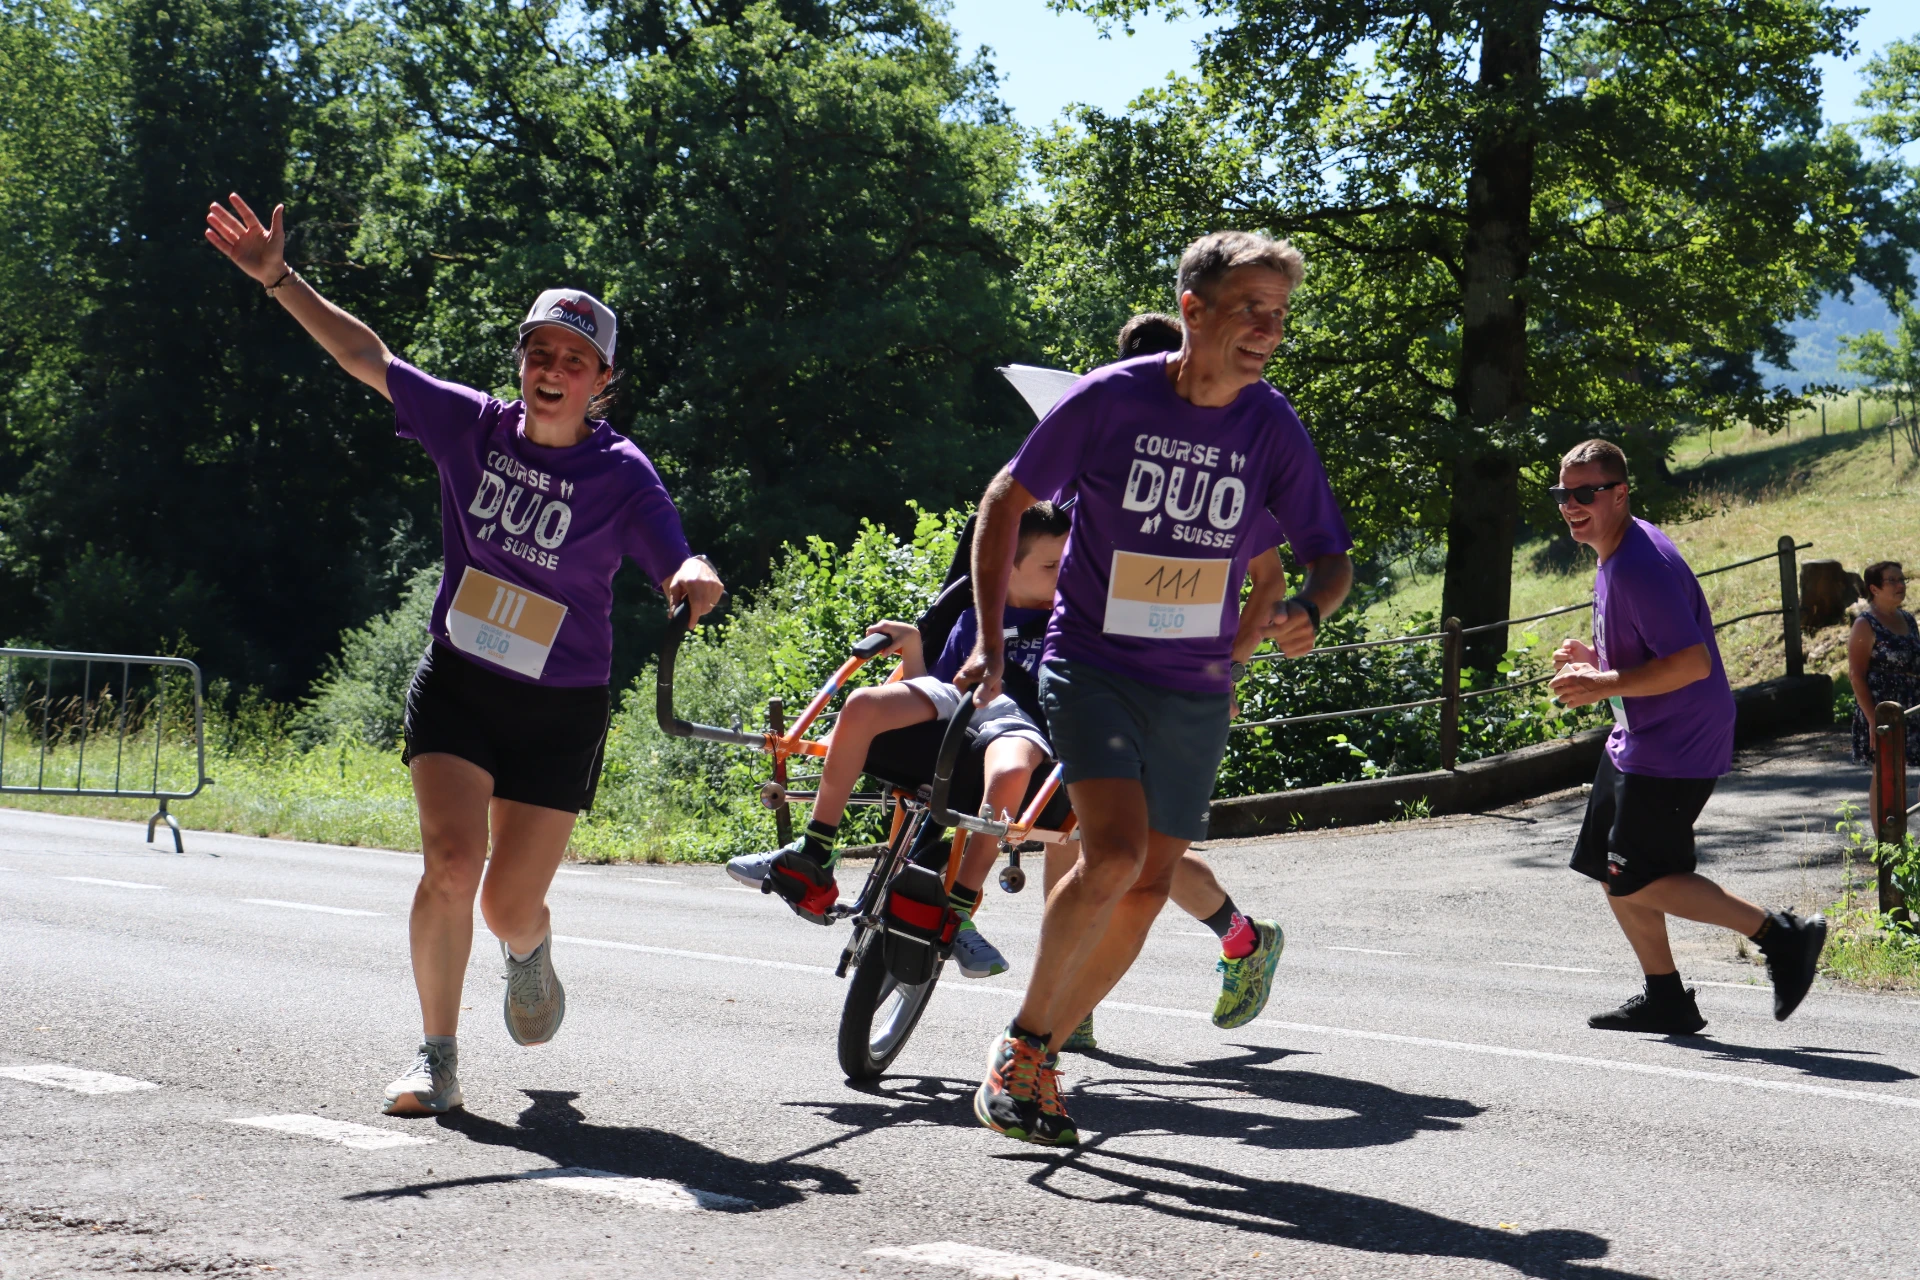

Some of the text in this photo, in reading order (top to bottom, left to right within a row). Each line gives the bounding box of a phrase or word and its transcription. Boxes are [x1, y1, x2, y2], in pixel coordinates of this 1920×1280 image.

[1134, 434, 1221, 468] COURSE
[487, 450, 552, 492] COURSE
[468, 469, 572, 550] DUO
[1122, 458, 1246, 530] DUO
[1171, 523, 1236, 548] SUISSE
[502, 536, 560, 571] SUISSE
[1144, 565, 1201, 600] 111
[487, 585, 528, 629] 111
[1148, 612, 1185, 628] DUO
[475, 630, 510, 654] DUO
